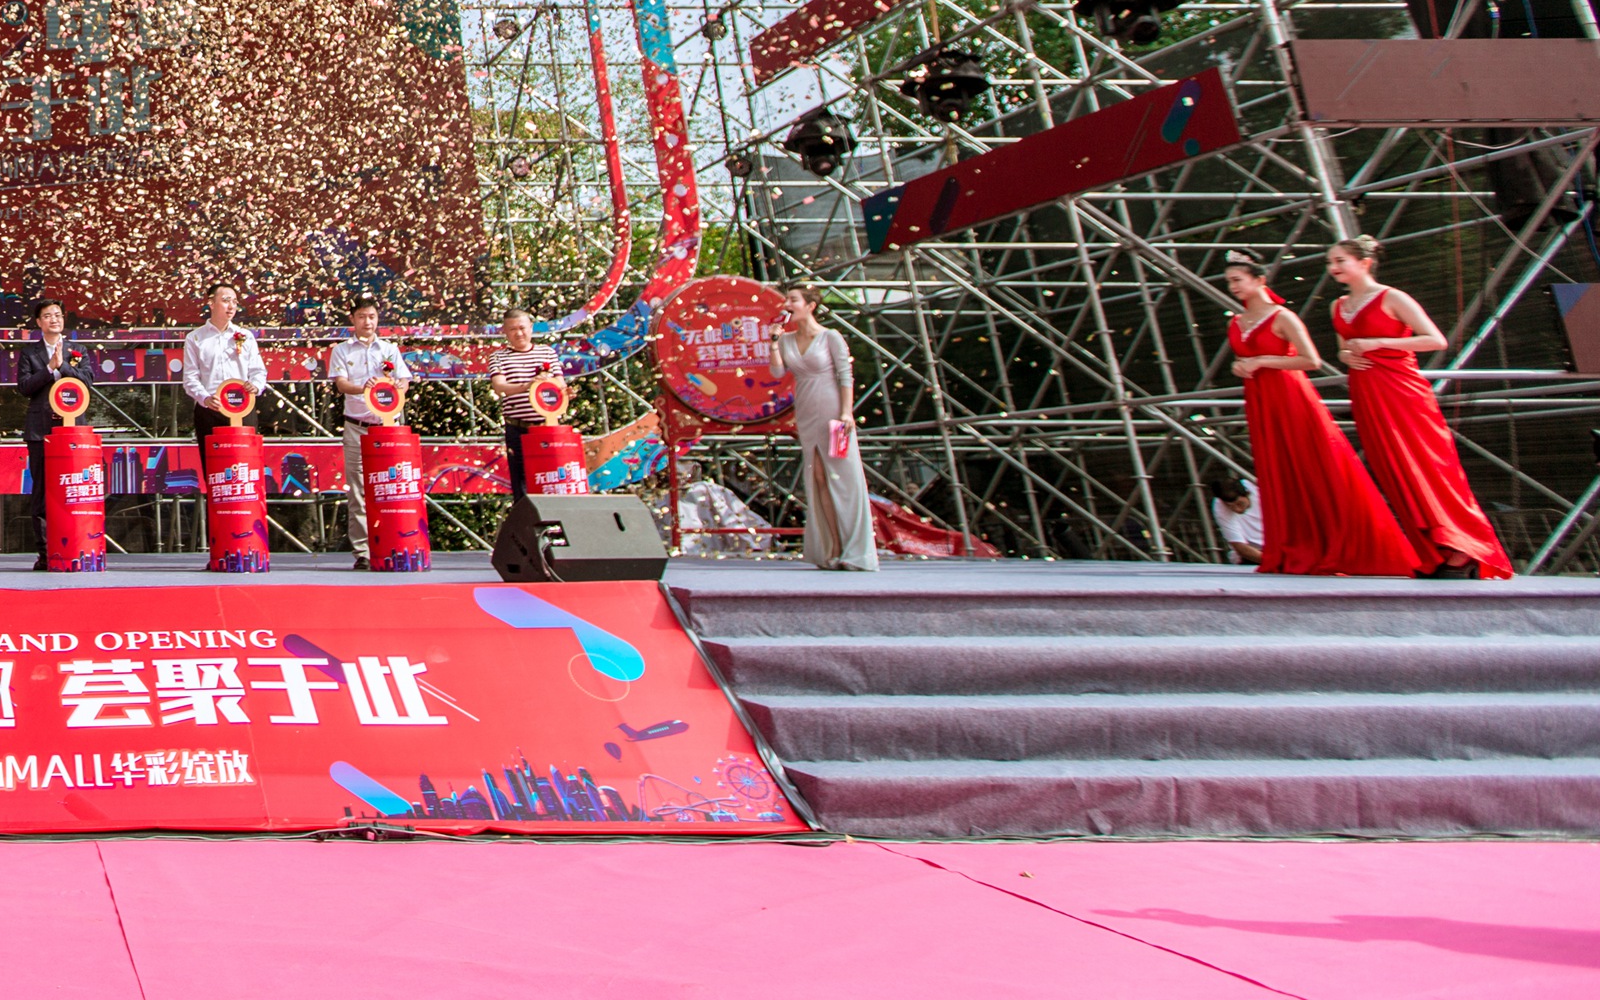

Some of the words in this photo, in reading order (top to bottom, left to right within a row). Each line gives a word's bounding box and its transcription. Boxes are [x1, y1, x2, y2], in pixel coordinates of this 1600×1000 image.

[94, 629, 278, 651] OPENING
[59, 655, 449, 728] 荟聚于此
